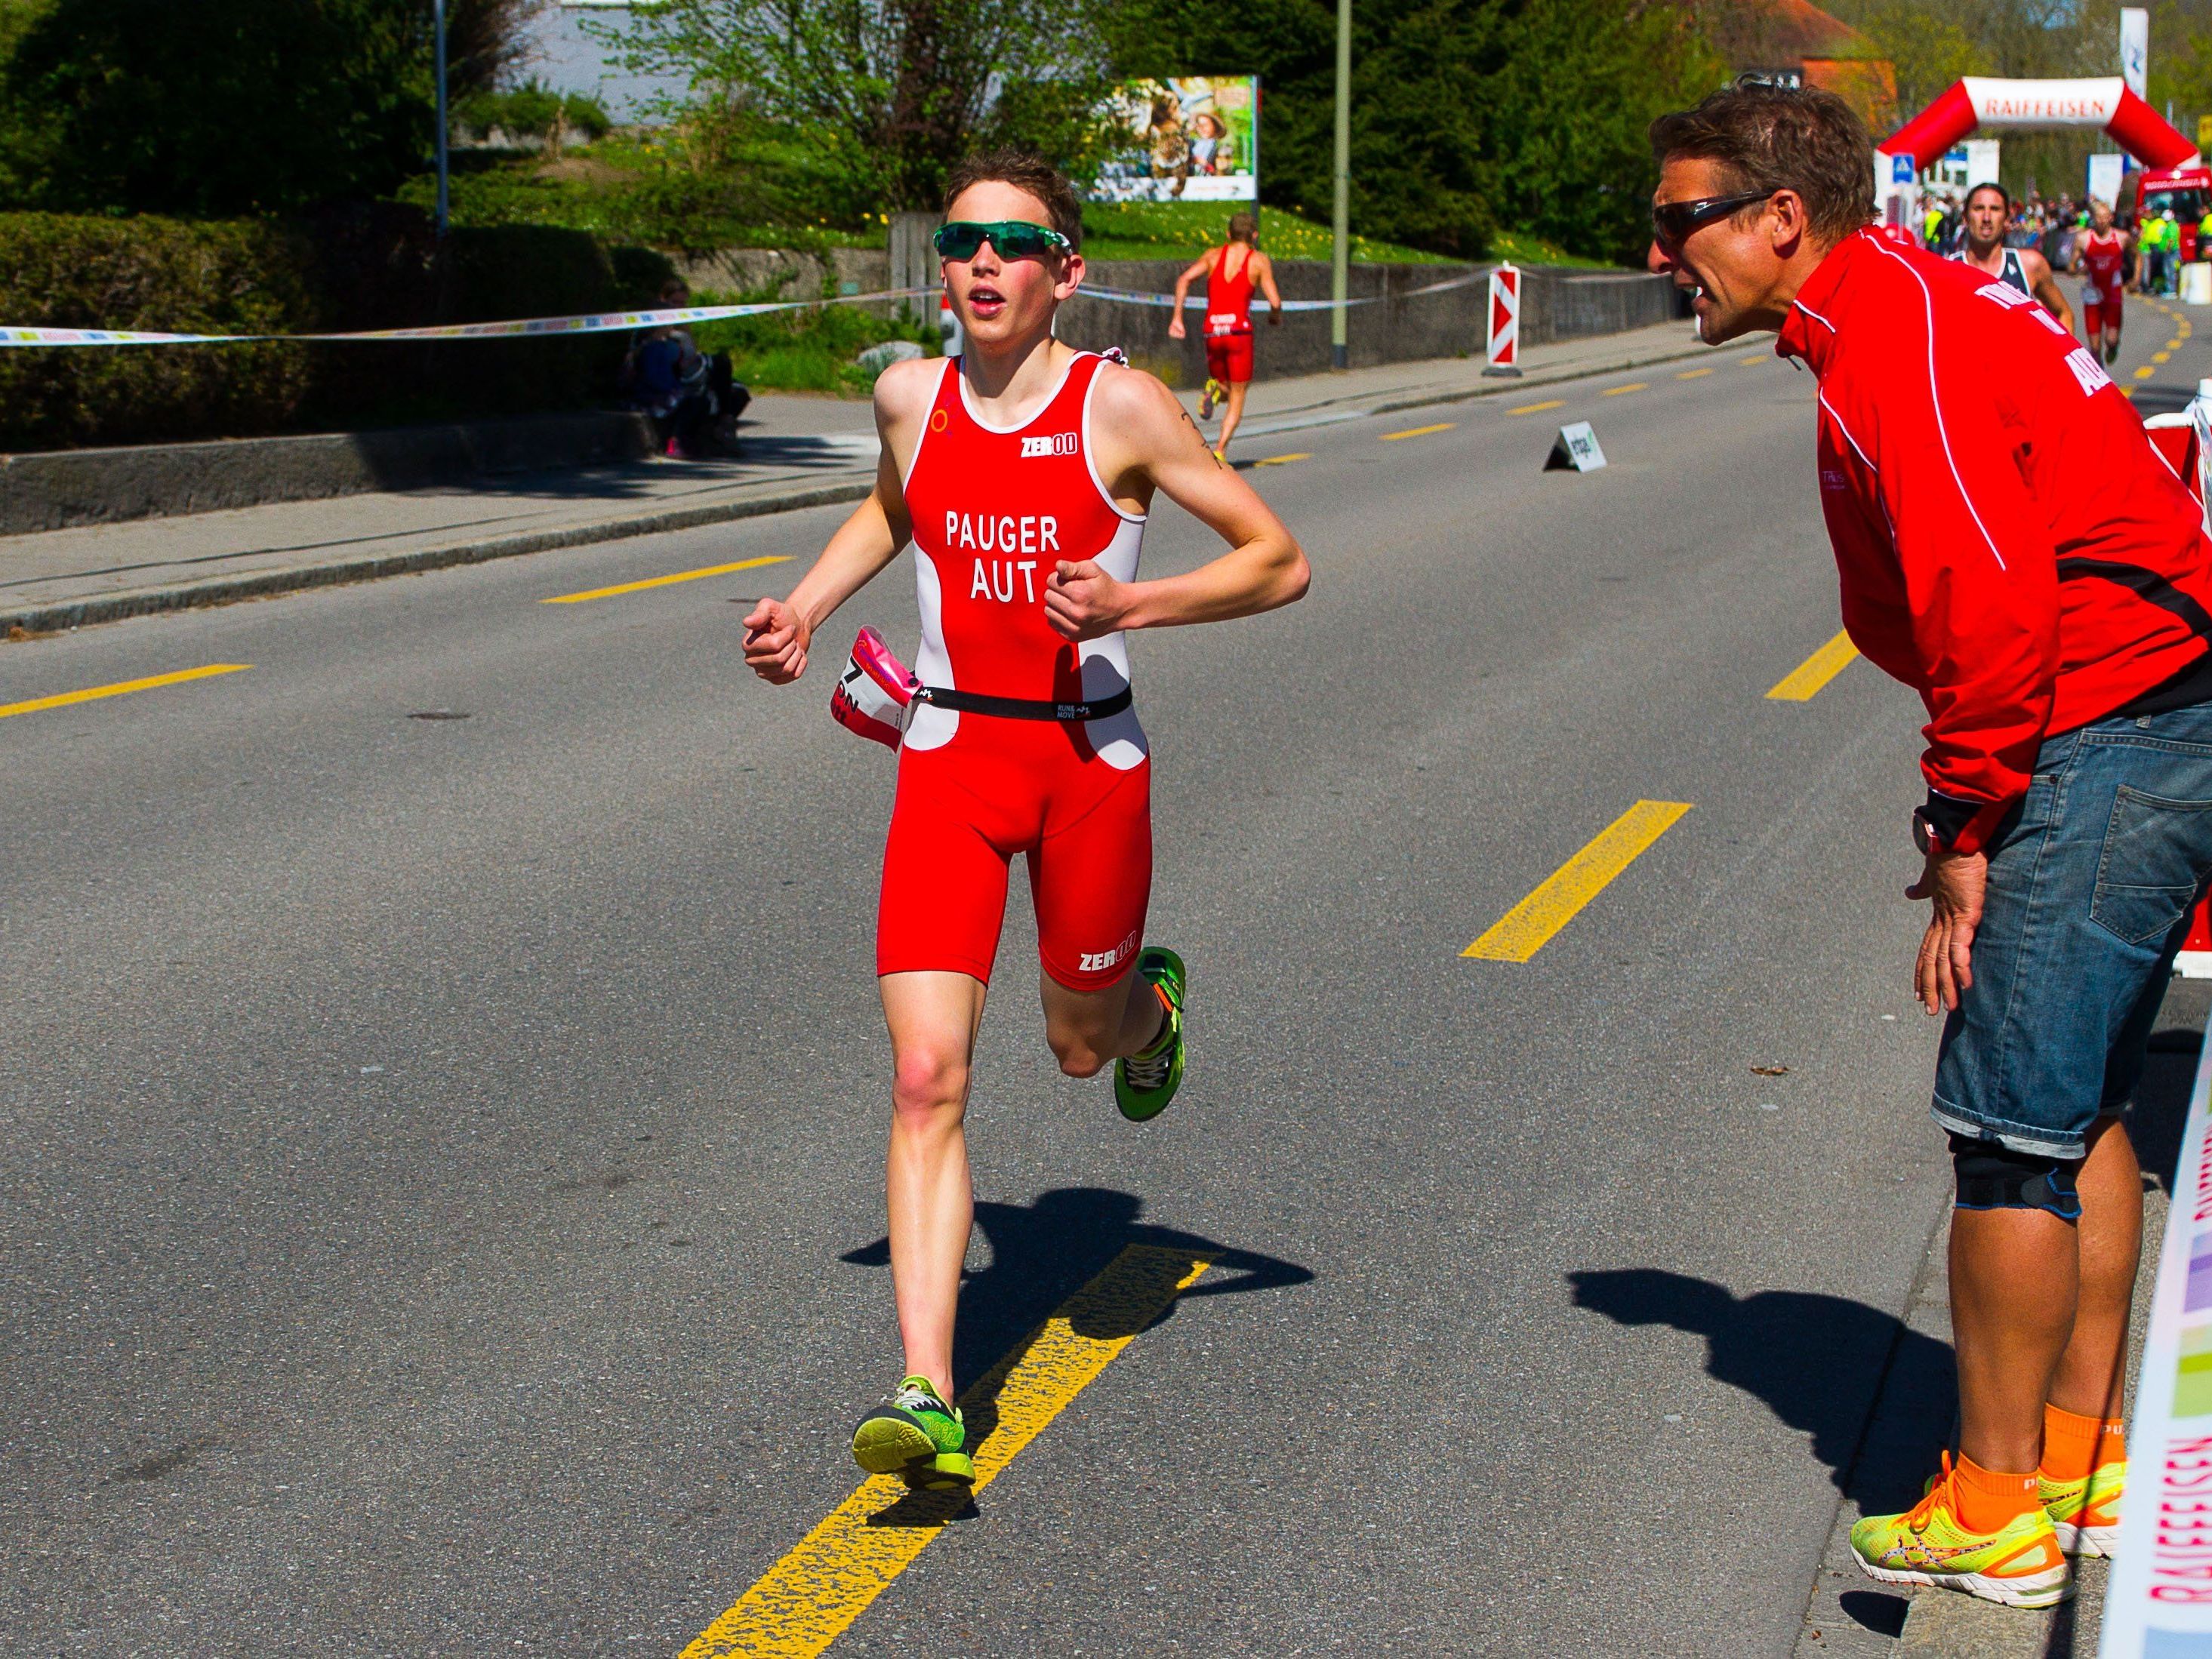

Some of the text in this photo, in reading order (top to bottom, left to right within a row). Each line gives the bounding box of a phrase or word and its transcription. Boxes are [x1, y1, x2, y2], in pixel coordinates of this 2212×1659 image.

[1986, 99, 2105, 117] RAIFFEISEN
[1020, 432, 1078, 458] ZEROD
[946, 510, 1060, 554] PAUGER
[970, 557, 1037, 604] AUT
[1079, 930, 1136, 971] ZEROD
[2101, 1424, 2125, 1435] PU
